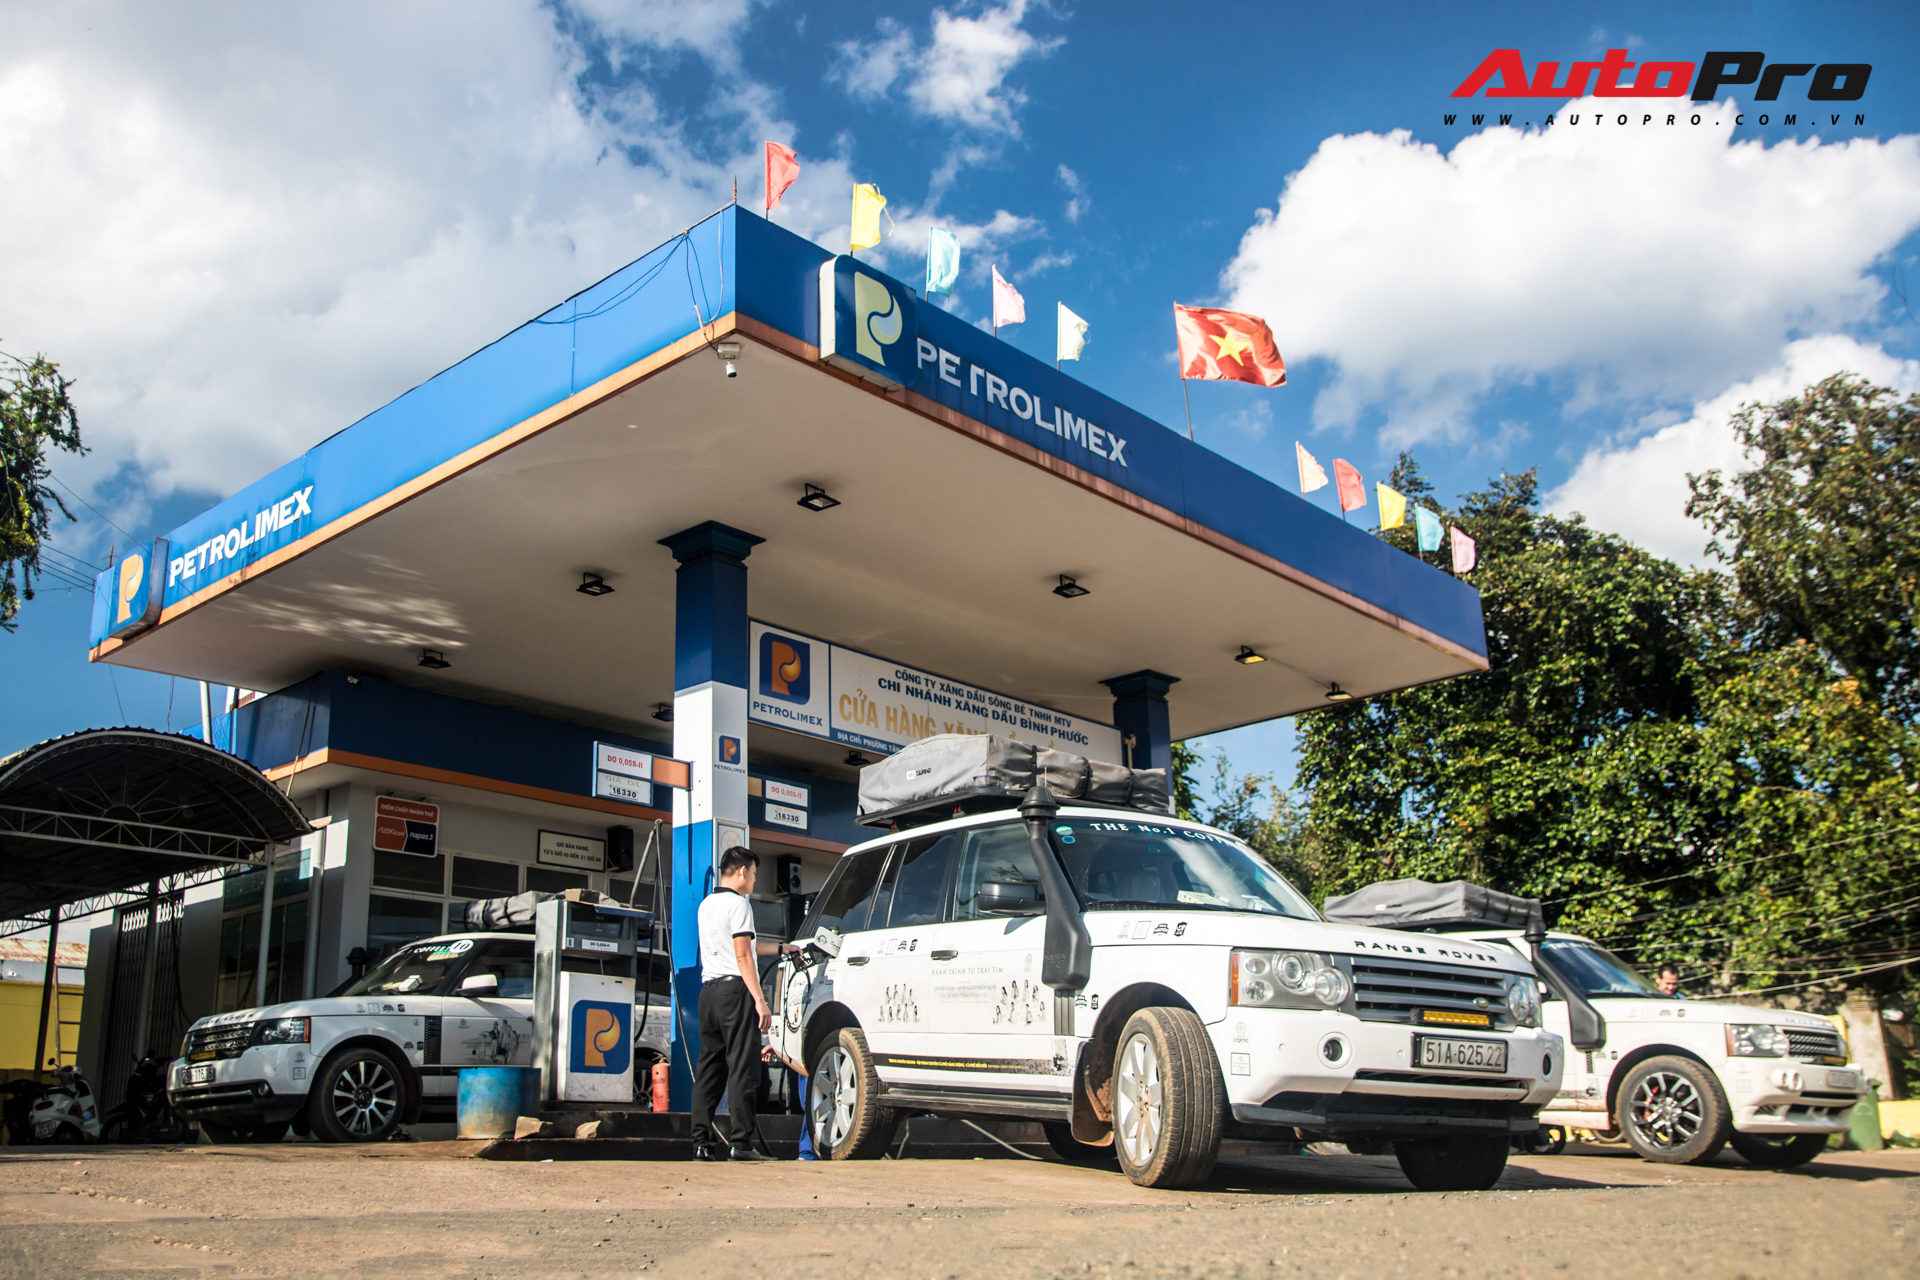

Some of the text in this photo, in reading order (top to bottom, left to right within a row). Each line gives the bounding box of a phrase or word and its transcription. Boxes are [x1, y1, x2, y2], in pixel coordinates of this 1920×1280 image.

[917, 337, 1129, 468] PETROLIMEX
[169, 485, 314, 588] PETROLIMEX
[895, 669, 1072, 728] CÔNG TY XĂNG DẦU SÔNG BÉ TNHH MTV
[753, 701, 823, 726] PETROLIMEX
[839, 688, 879, 729] CỬA
[885, 704, 937, 741] HÀNG
[878, 677, 901, 693] CHI
[905, 685, 951, 708] NHÁNH
[955, 699, 989, 718] XĂNG
[992, 709, 1017, 726] DẦU
[1020, 717, 1049, 735] BÌNH
[1050, 726, 1089, 746] PHƯỚC
[607, 755, 617, 763] DO
[713, 763, 747, 775] PETROLIMEX
[612, 787, 637, 798] 16330
[771, 786, 780, 794] DO
[778, 812, 799, 822] 16330
[409, 832, 429, 841] napas
[1090, 823, 1128, 831] THE
[1138, 825, 1176, 835] No.1
[1354, 940, 1498, 963] RANGE ROVER
[1426, 1041, 1502, 1067] 51A-625.22
